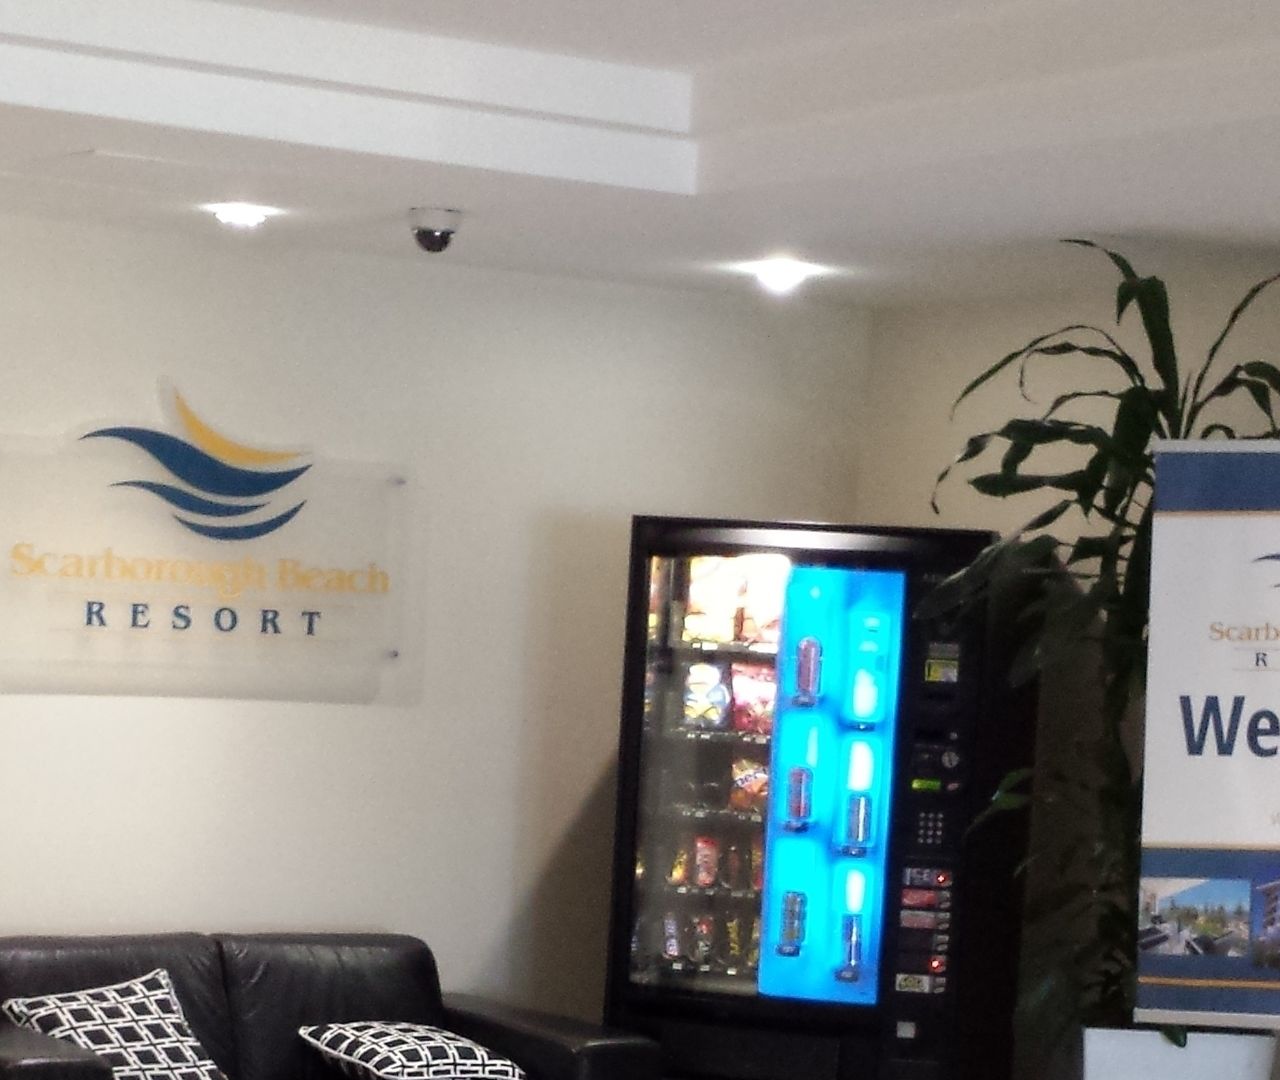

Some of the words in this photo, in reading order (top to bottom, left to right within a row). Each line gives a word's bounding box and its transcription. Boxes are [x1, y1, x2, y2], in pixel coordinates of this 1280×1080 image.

[10, 541, 268, 598] Scarborough
[275, 557, 390, 595] Beach
[85, 600, 320, 636] RESORT
